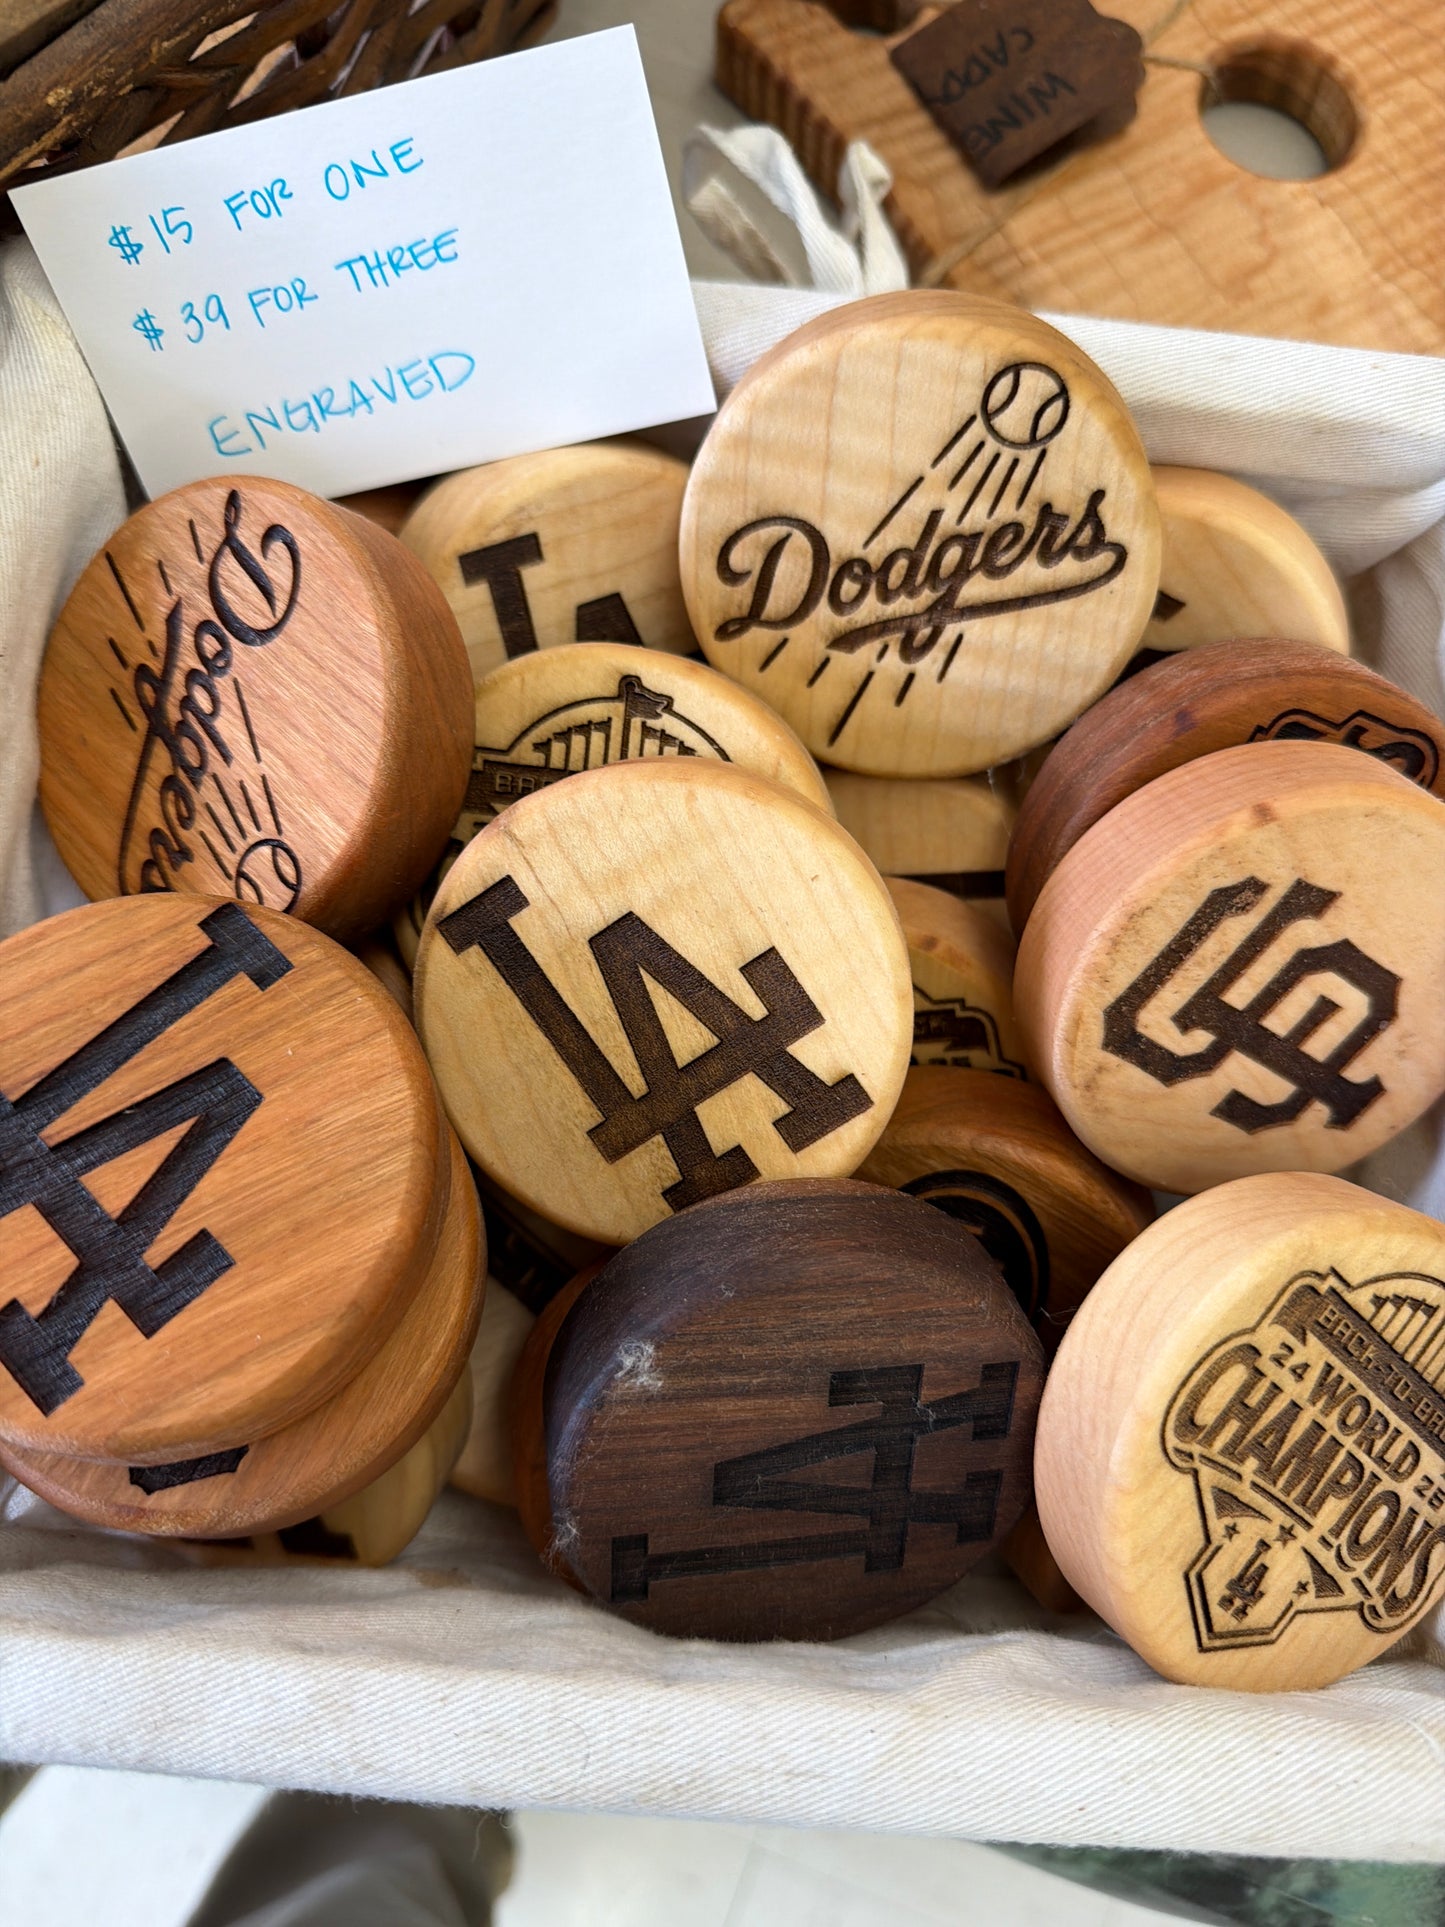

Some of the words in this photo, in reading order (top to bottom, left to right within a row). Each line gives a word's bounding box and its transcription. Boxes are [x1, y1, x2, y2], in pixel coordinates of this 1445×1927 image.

[961, 72, 1078, 158] WINE
[109, 206, 193, 265] $15
[225, 178, 293, 230] FOR
[324, 137, 423, 201] ONE
[247, 278, 318, 327] FOR
[335, 228, 459, 294] THREE
[208, 350, 475, 457] ENGRAVED
[714, 489, 1127, 664] Dodgers
[436, 874, 875, 1213] LA
[1101, 876, 1403, 1135] SF
[0, 902, 294, 1417] LA
[1269, 1341, 1311, 1383] 24
[1307, 1361, 1421, 1483] WORLD
[1318, 1306, 1445, 1443] BACK-TO-BA
[611, 1361, 1019, 1600] LA
[1174, 1343, 1445, 1617] CHAMPIONS
[1217, 1538, 1272, 1623] LA
